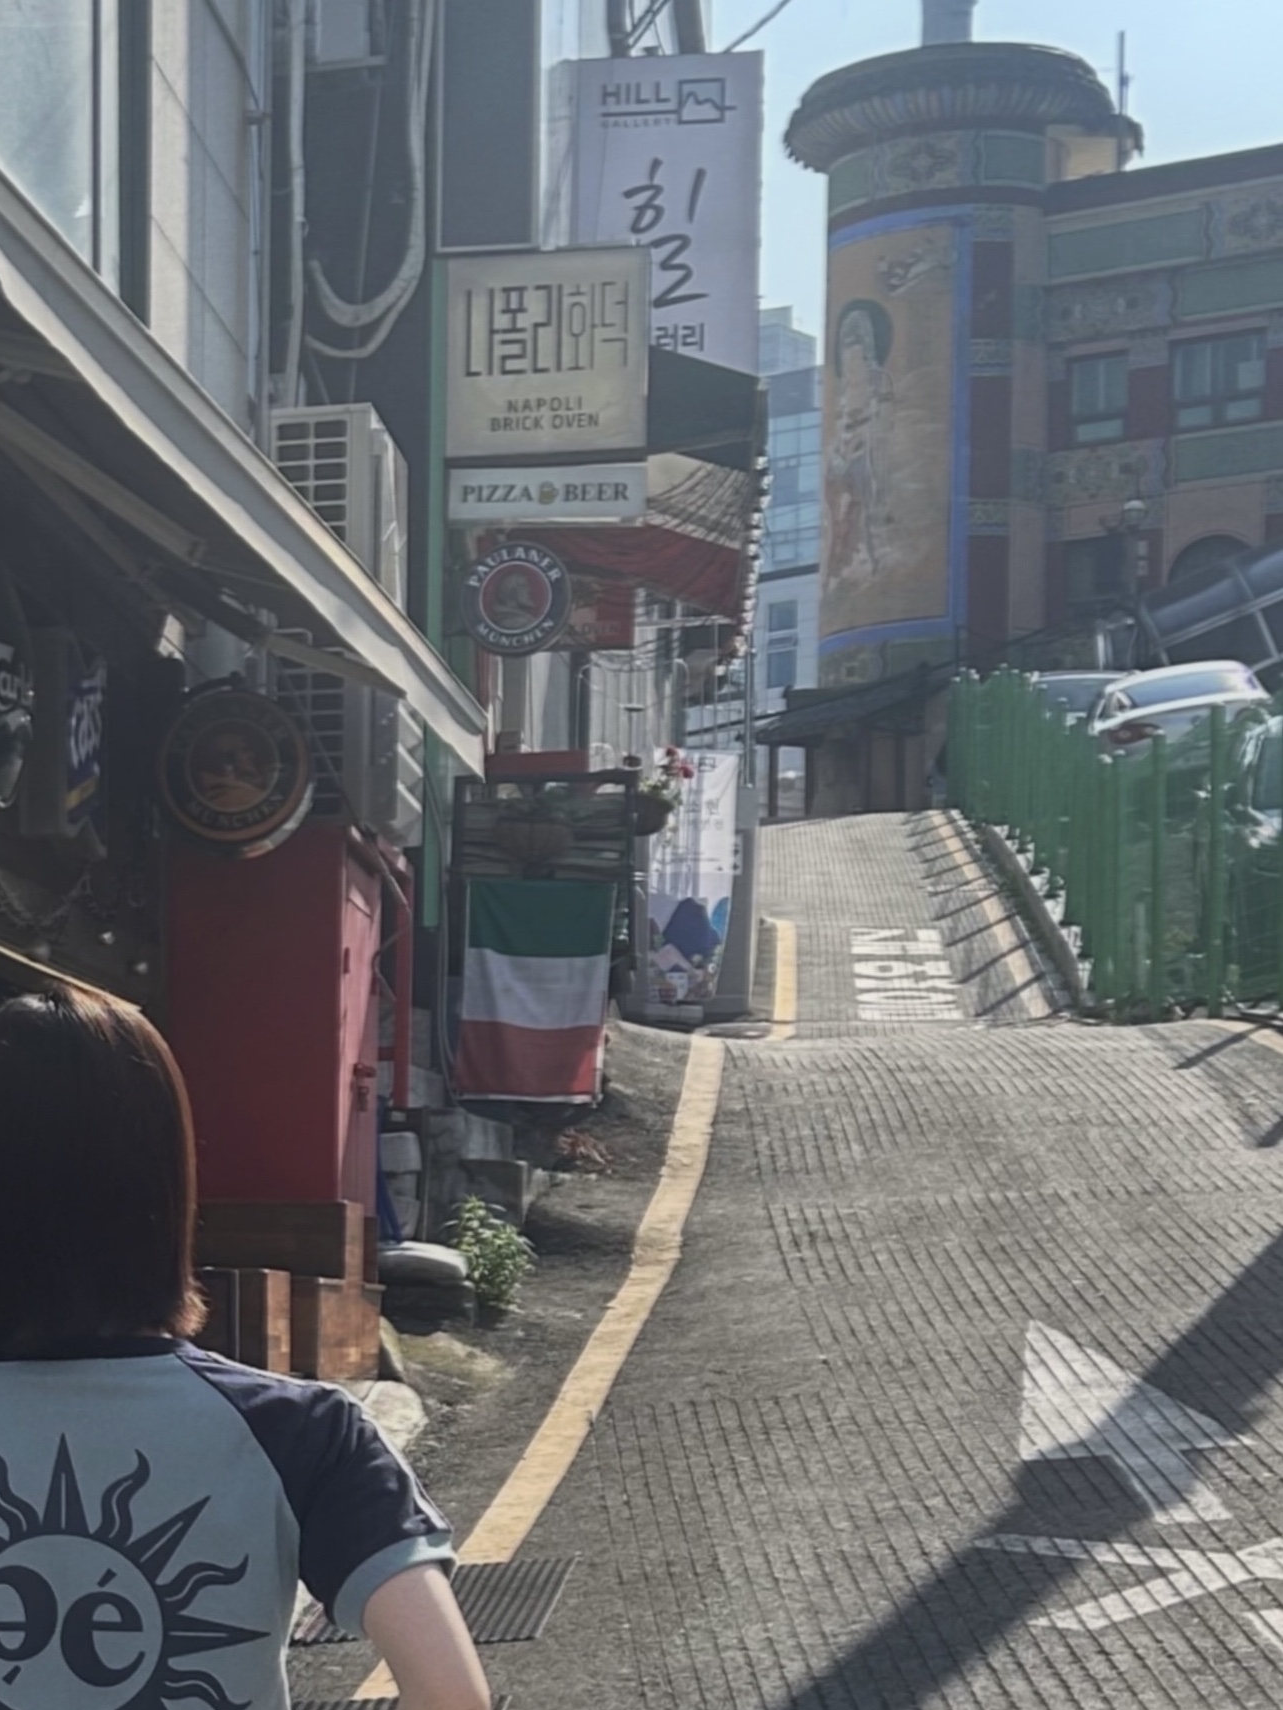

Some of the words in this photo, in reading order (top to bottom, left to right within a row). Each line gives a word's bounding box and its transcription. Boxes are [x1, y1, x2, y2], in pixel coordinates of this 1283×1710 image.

[601, 81, 671, 106] HILL
[623, 157, 710, 308] 힐
[465, 281, 629, 377] 나폴리화덕
[507, 396, 583, 414] NAPOLI
[489, 414, 545, 432] BRICK
[551, 412, 600, 430] OVEN
[461, 484, 535, 504] PIZZA
[562, 482, 630, 502] BEER
[463, 545, 563, 589] PAULANER
